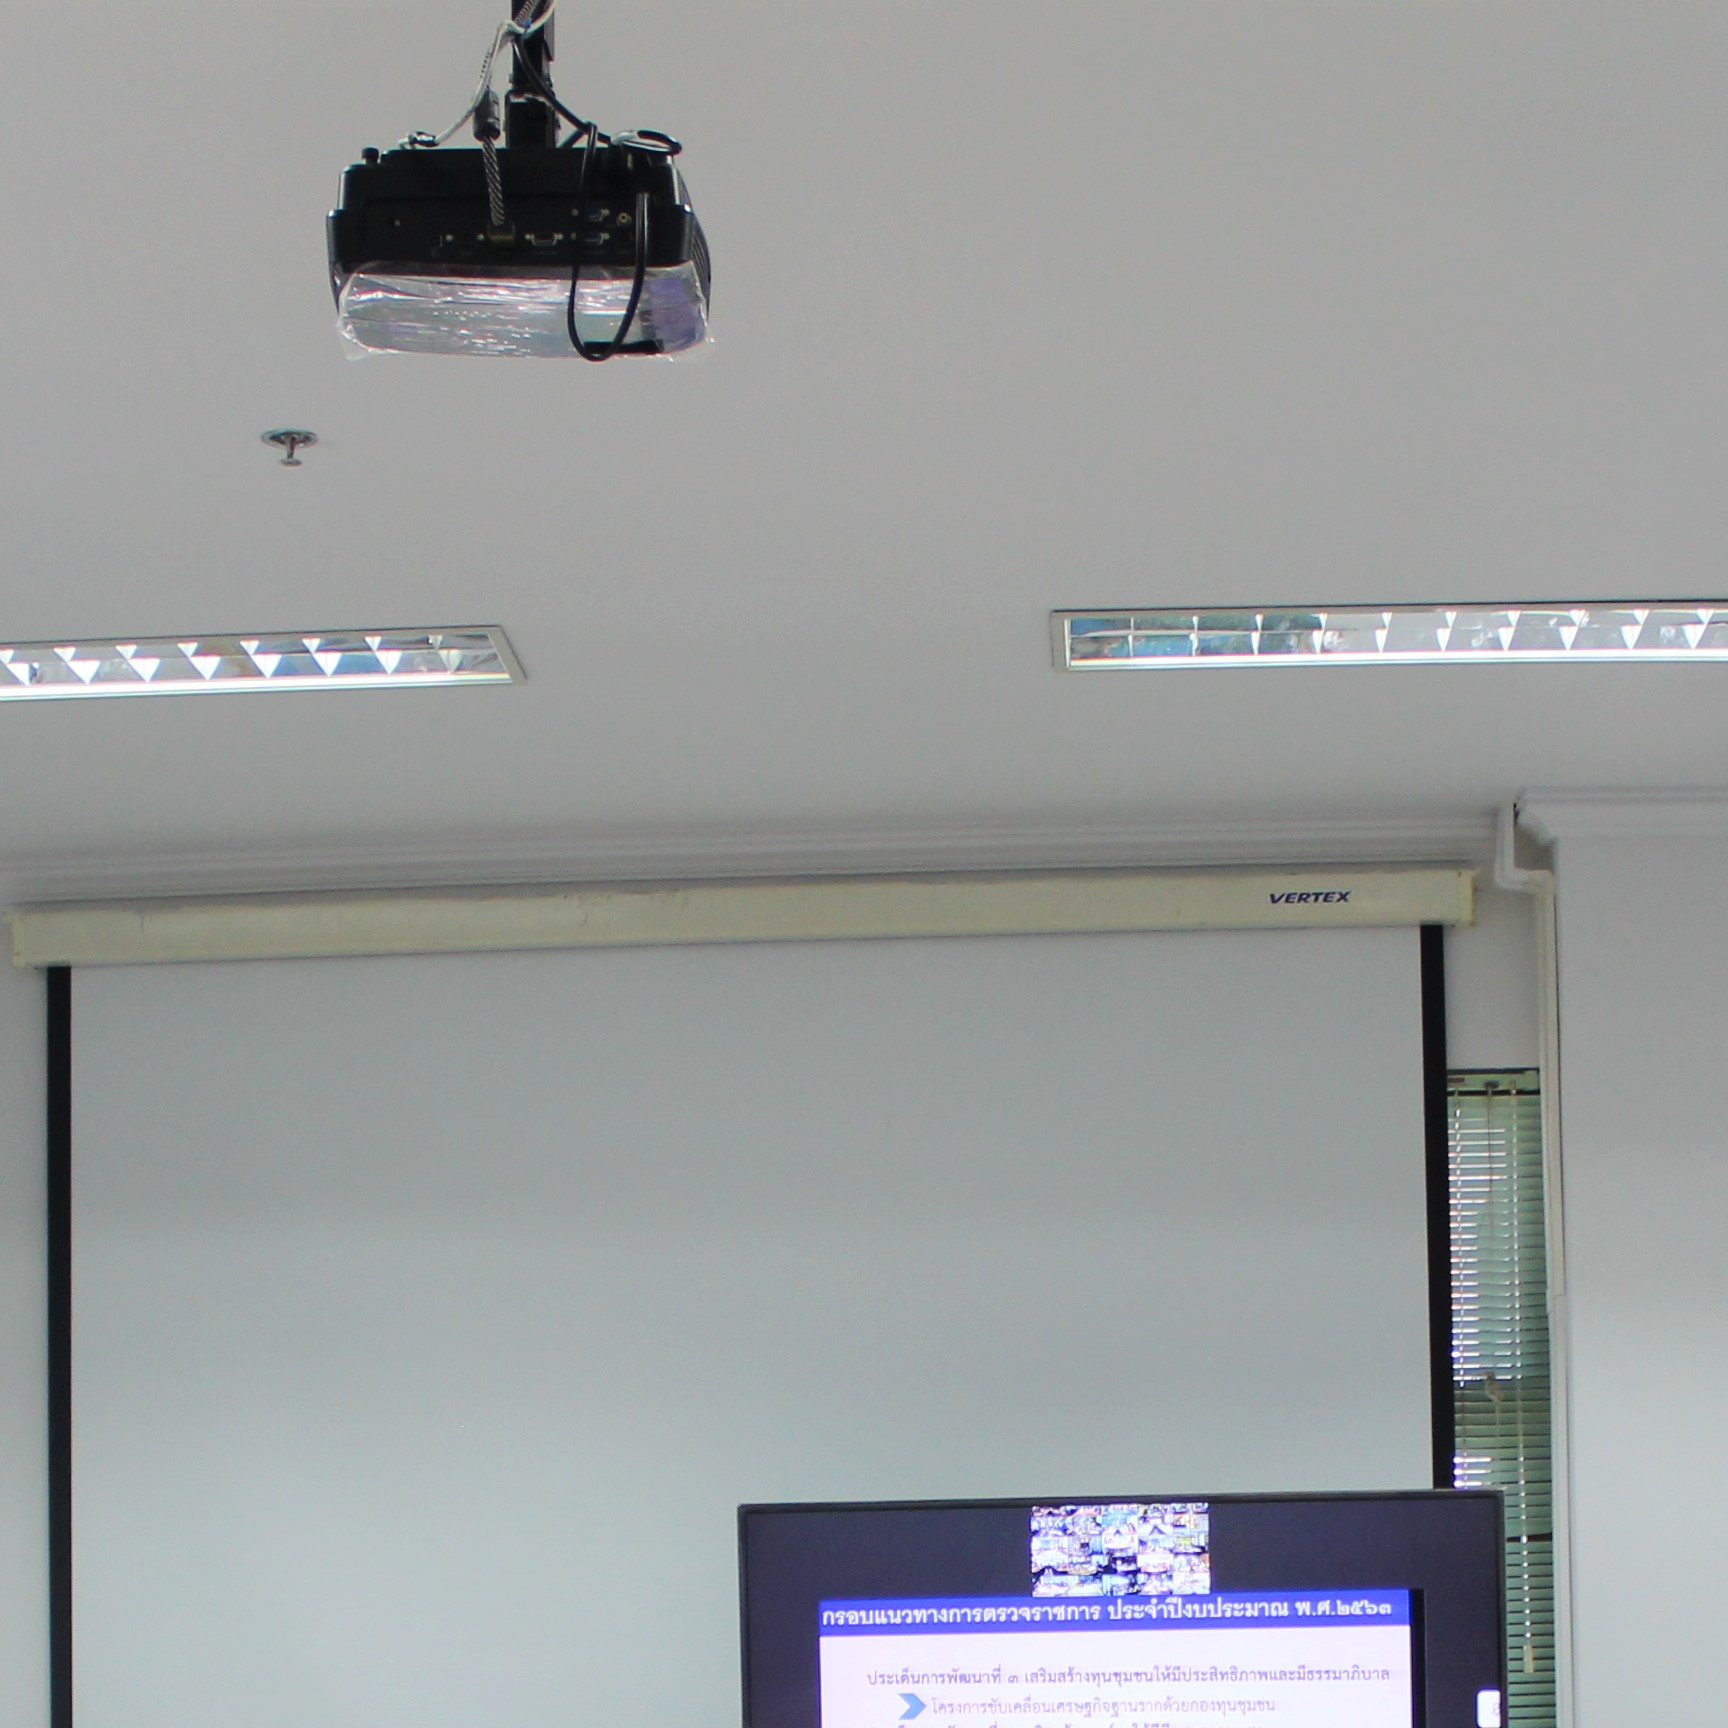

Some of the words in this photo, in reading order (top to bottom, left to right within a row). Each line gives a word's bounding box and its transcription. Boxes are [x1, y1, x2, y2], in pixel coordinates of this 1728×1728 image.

[1269, 890, 1352, 905] VERTEX
[822, 1604, 1101, 1626] กรอบแนวทางการตรวจราชการ
[1108, 1597, 1290, 1620] ประจำปีงบประมาณ
[1295, 1599, 1393, 1617] พ.ศ.๒๕๖๓
[866, 1664, 1002, 1686] ประเด็นการพัฒนาที่
